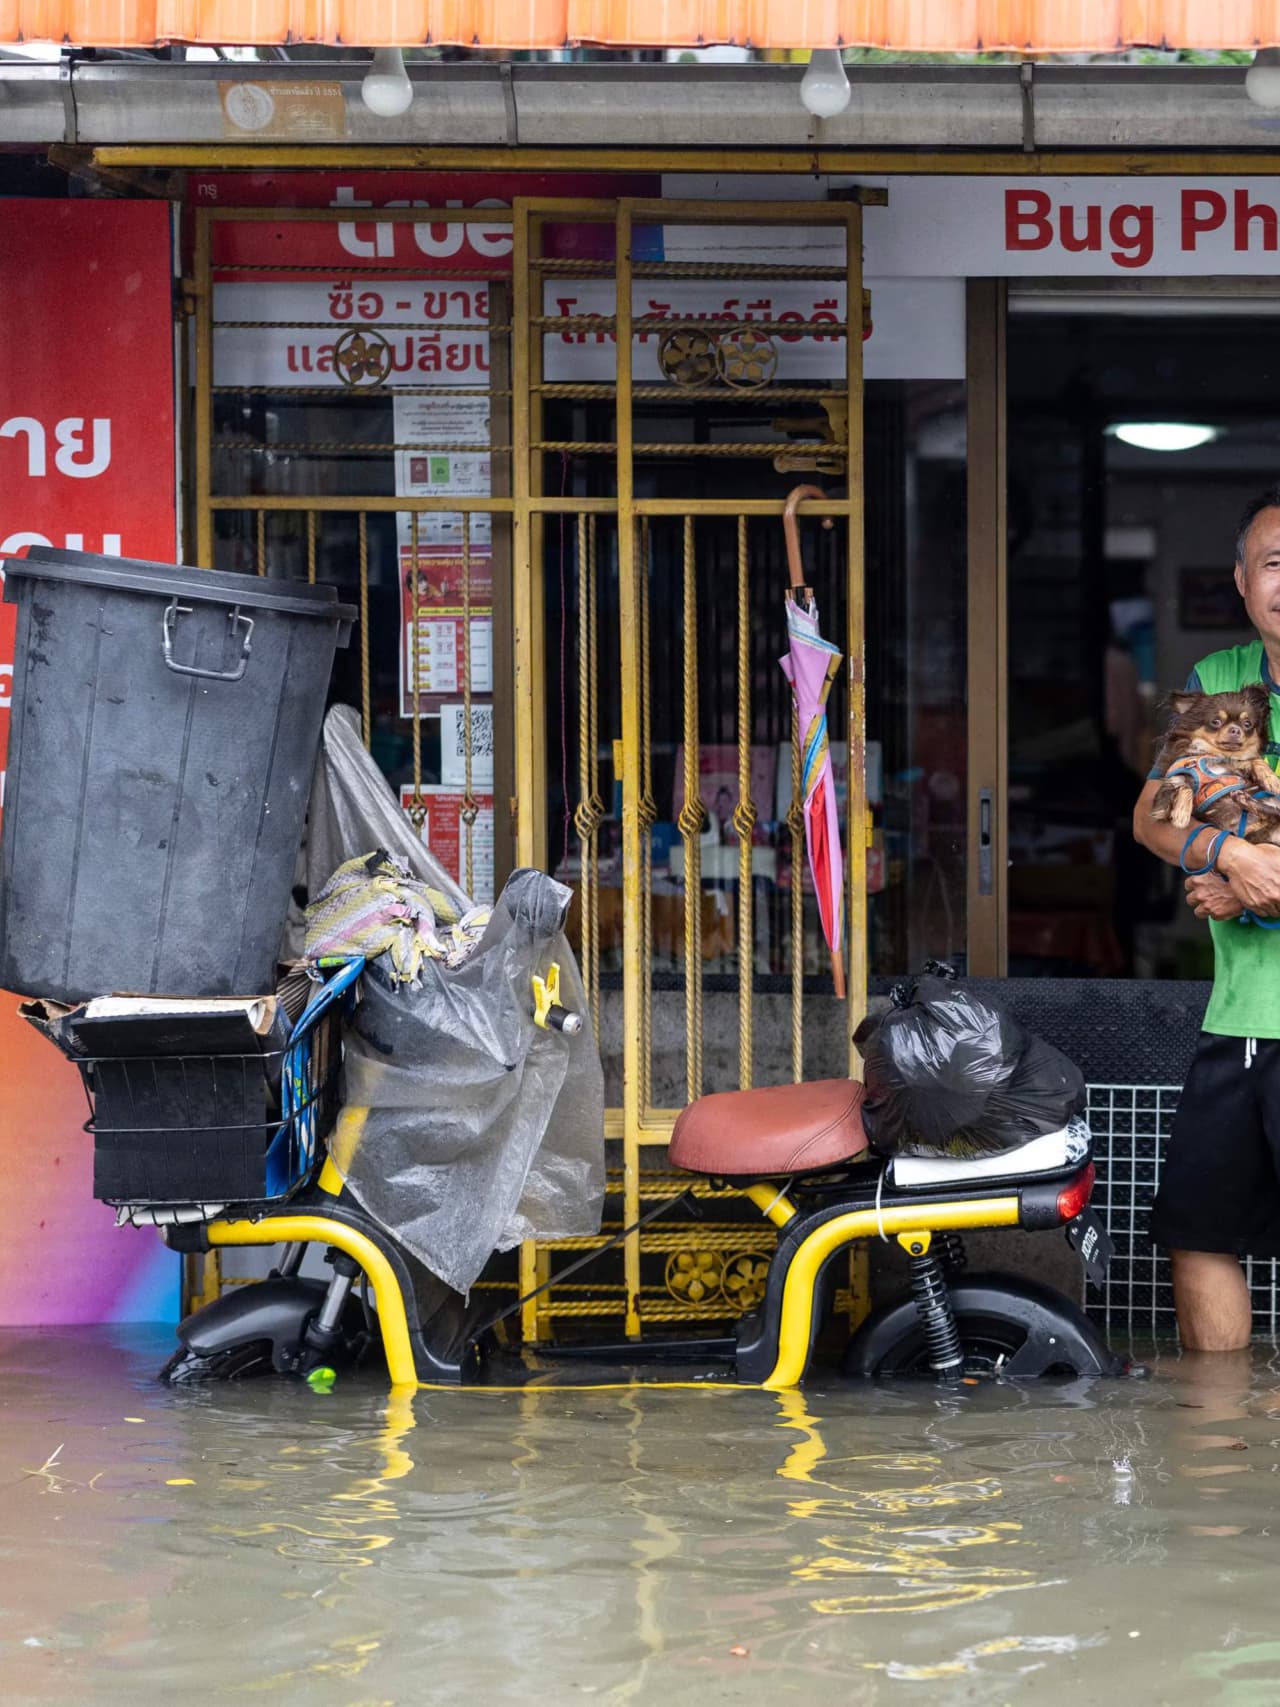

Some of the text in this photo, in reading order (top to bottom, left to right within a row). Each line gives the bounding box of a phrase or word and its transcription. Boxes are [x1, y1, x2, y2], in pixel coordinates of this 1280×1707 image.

[198, 183, 217, 199] ทรู
[329, 186, 514, 258] true
[1004, 189, 1154, 269] Bug
[328, 280, 385, 320] ซือ
[396, 299, 412, 309] -
